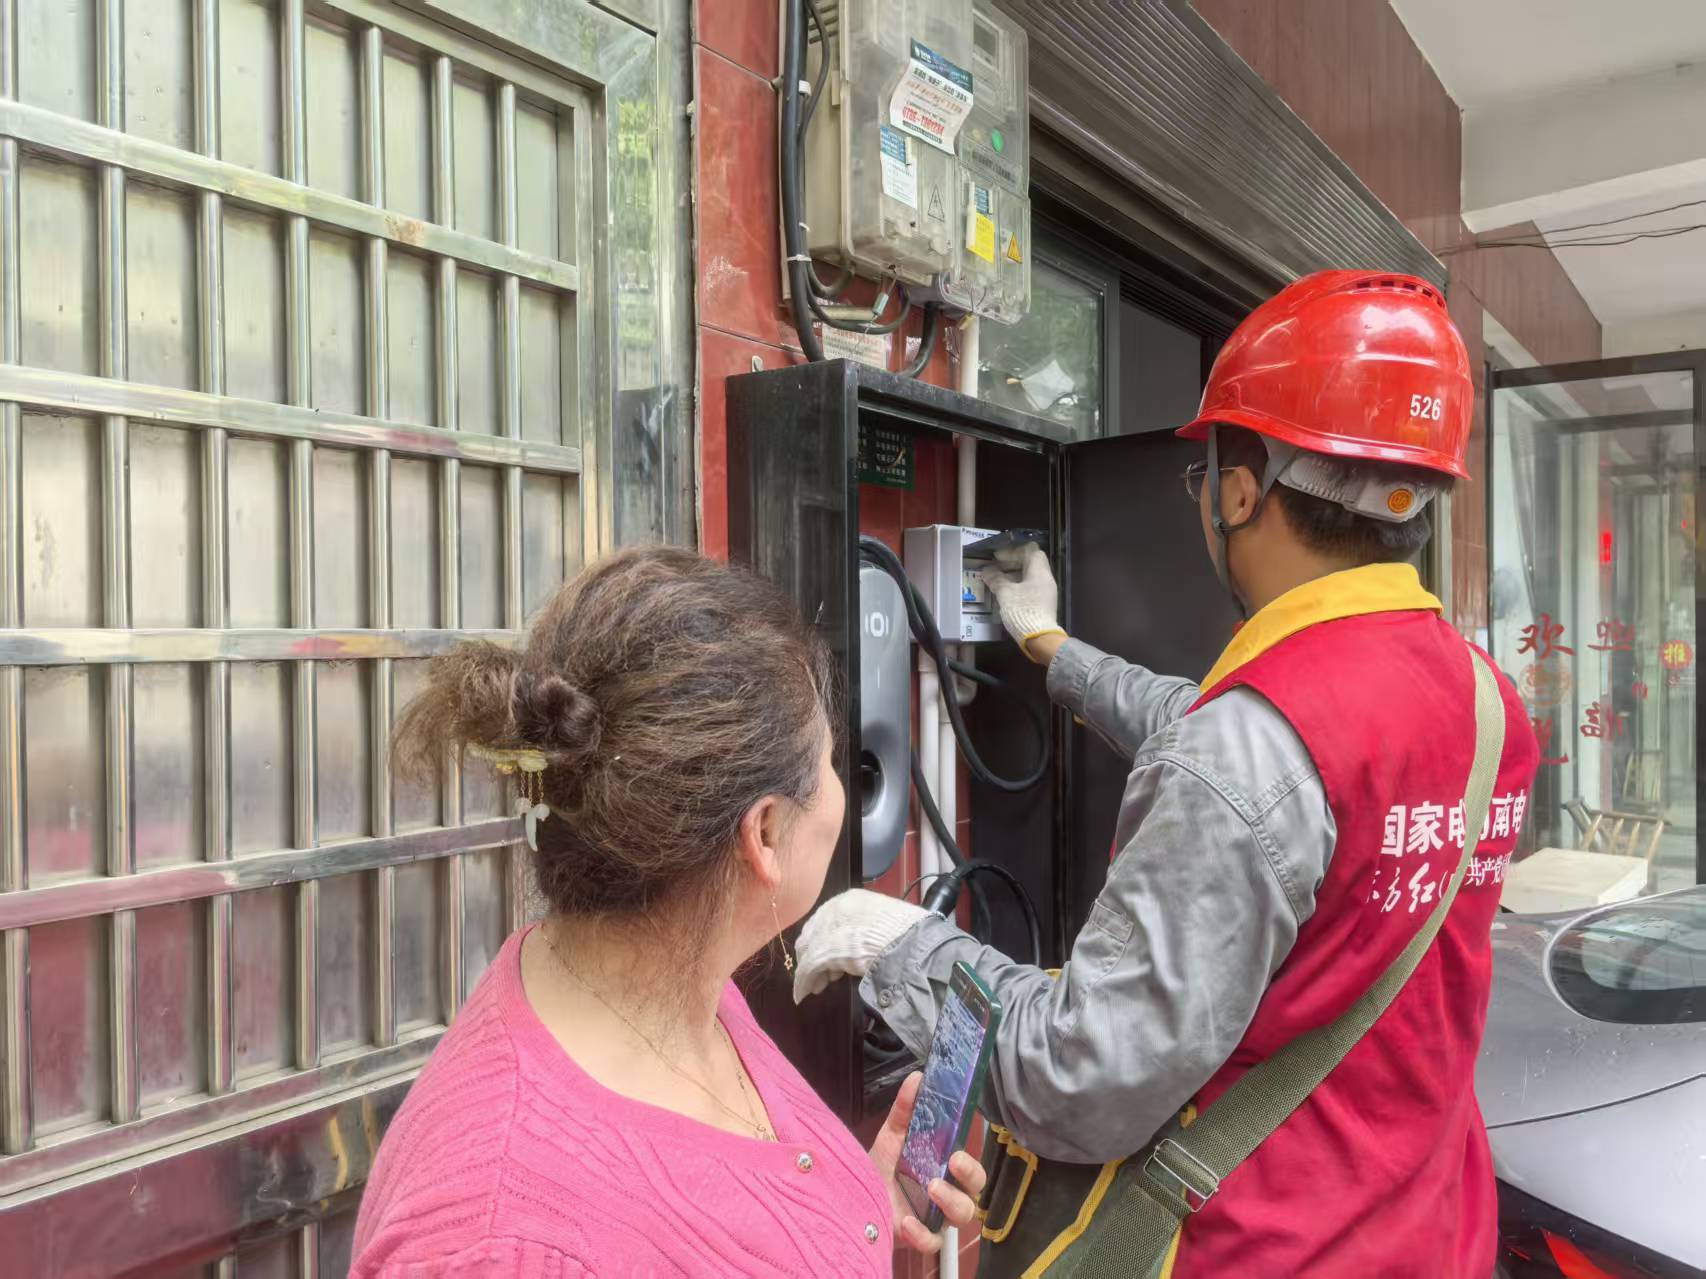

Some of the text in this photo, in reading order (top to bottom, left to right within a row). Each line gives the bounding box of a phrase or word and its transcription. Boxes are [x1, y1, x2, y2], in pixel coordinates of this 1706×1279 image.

[1410, 394, 1441, 420] 526
[1381, 789, 1527, 857] 国家电南电
